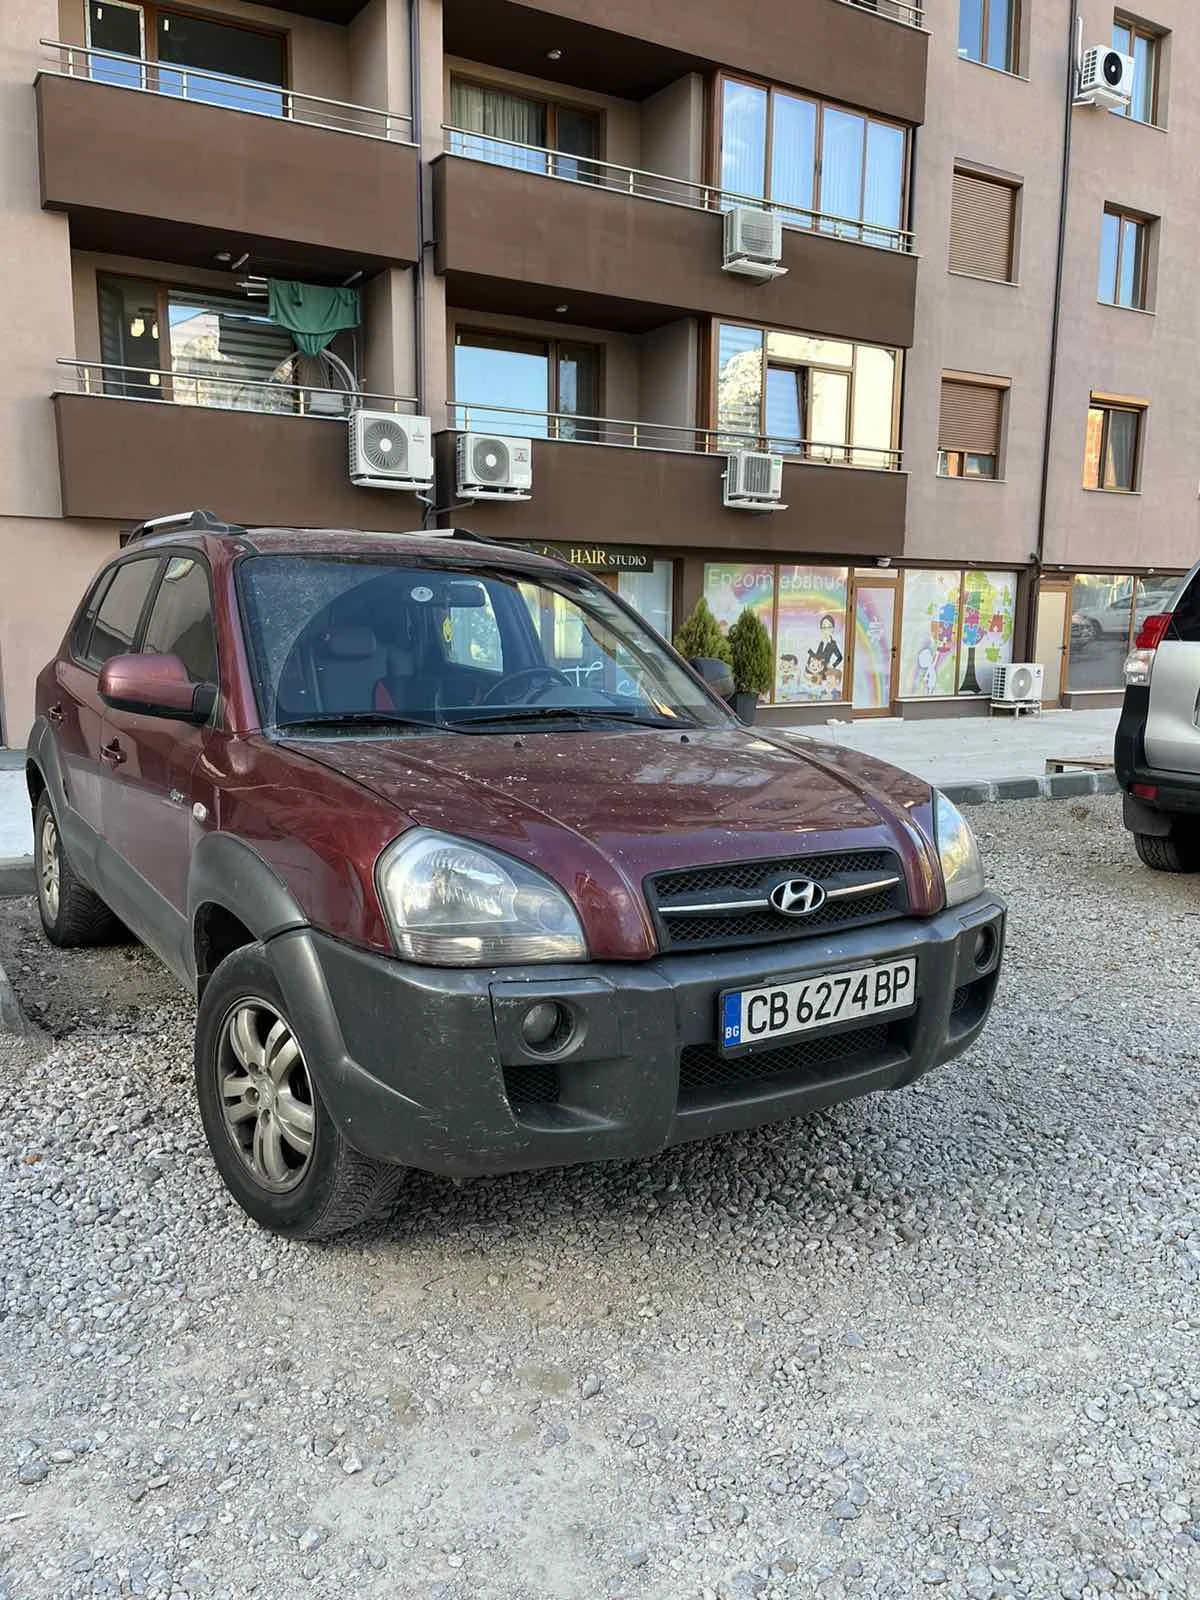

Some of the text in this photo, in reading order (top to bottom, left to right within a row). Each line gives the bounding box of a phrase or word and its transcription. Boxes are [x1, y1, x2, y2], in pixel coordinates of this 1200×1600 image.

[570, 548, 608, 565] HAIR
[608, 554, 647, 566] STUDIO
[747, 965, 910, 1035] CB 6274 BP
[724, 1024, 740, 1039] BG
